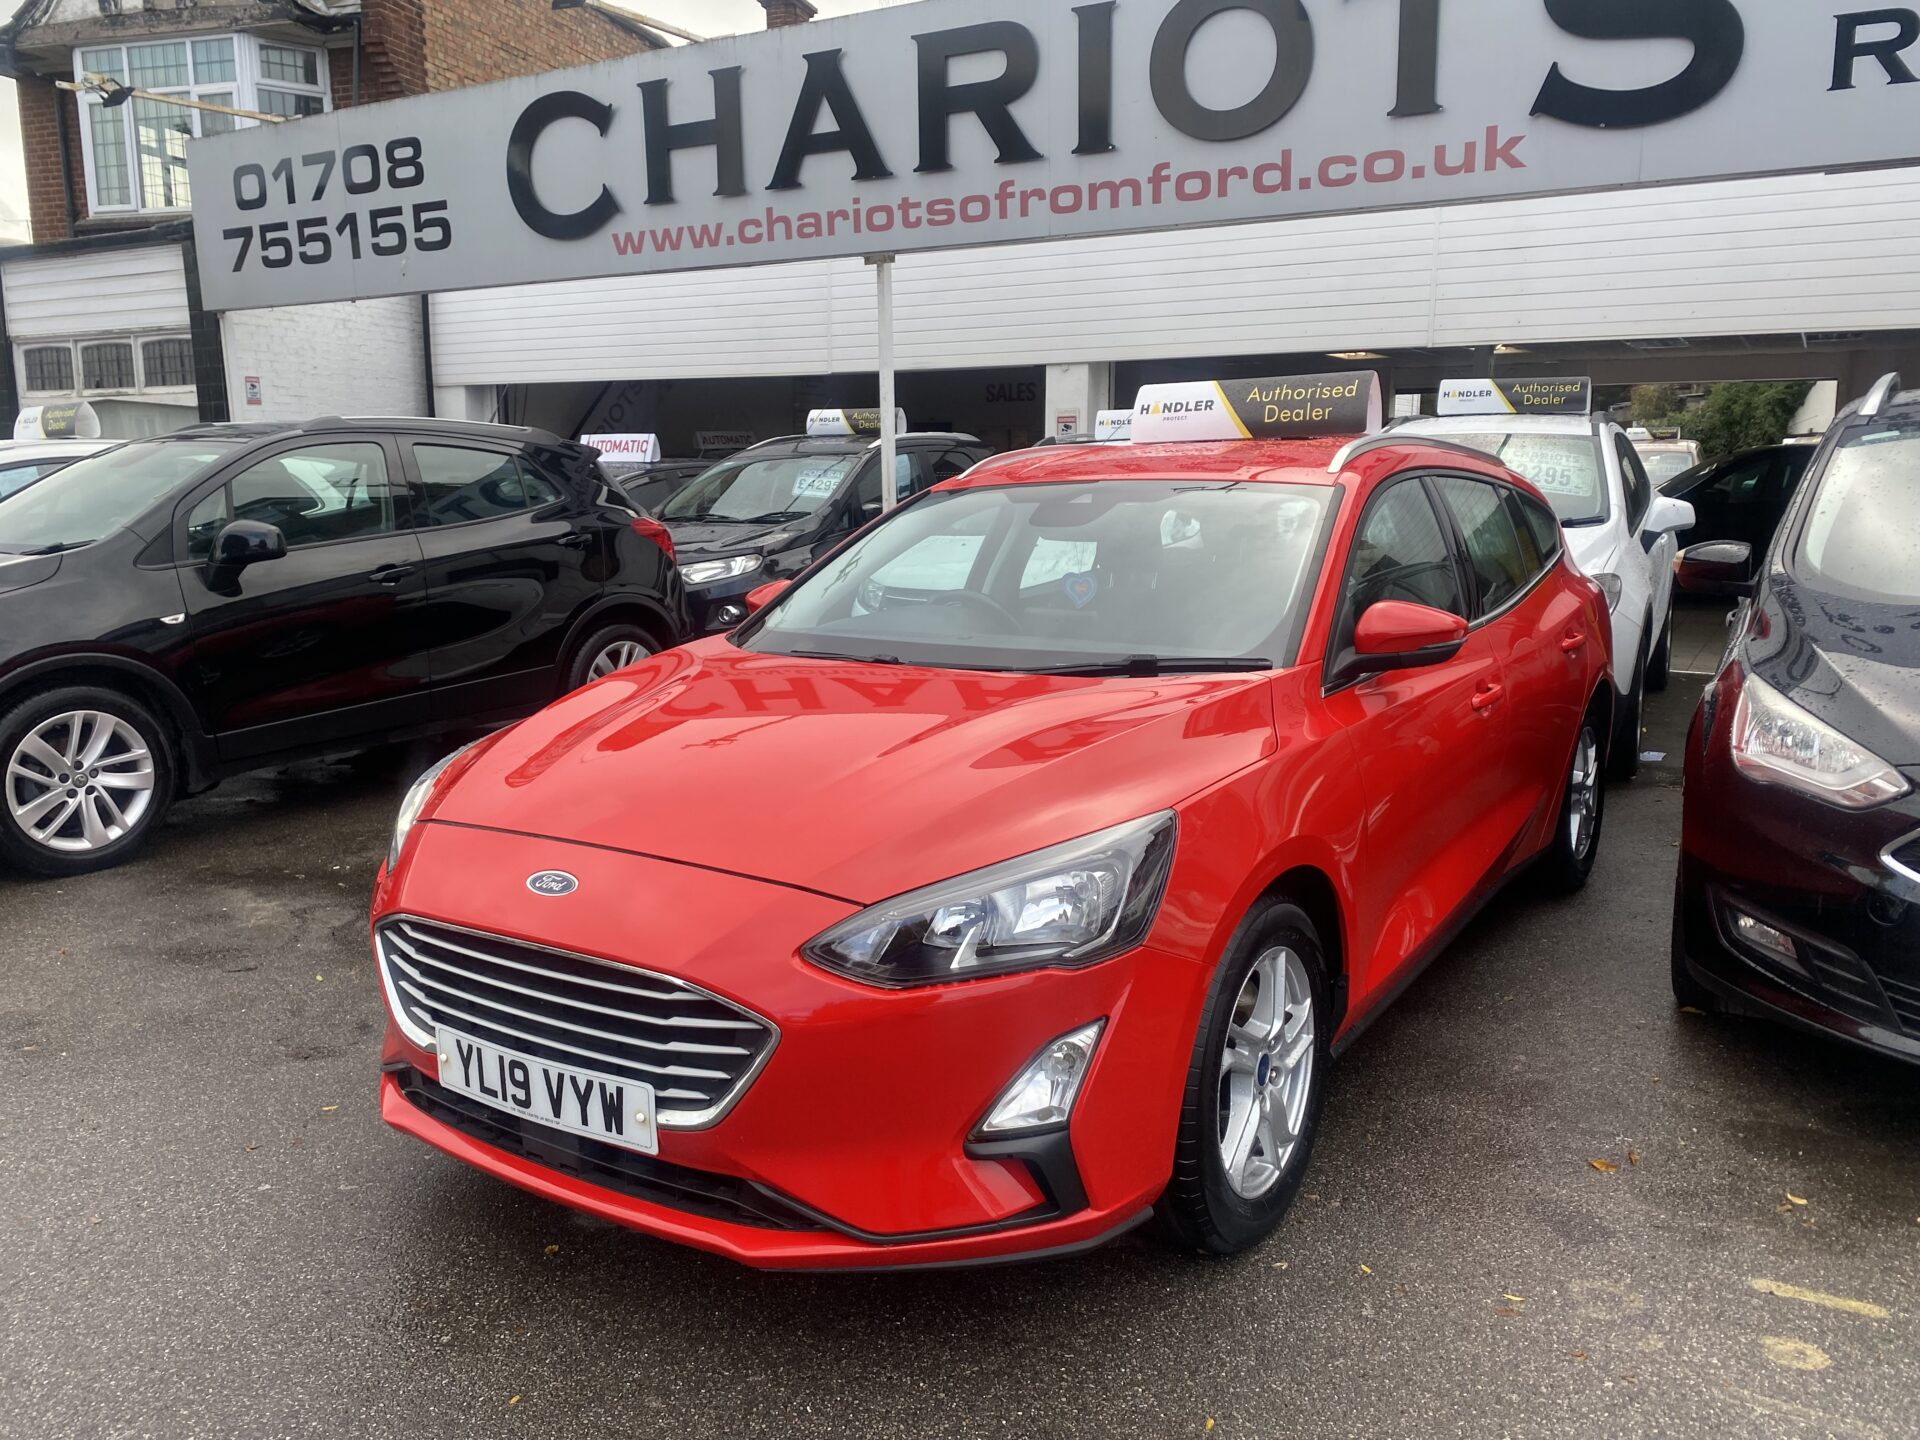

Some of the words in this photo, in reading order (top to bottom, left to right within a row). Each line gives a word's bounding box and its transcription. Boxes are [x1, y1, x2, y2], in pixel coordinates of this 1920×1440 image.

[233, 136, 425, 211] 01708
[612, 125, 1527, 256] www.chariotsofromford.co.uk
[222, 199, 452, 273] 755155
[985, 382, 1037, 403] SALES
[1246, 379, 1359, 403] Authorised
[1443, 390, 1492, 399] HANDLER
[1512, 381, 1582, 393] Authorised
[1140, 399, 1215, 416] HANDLER
[1523, 394, 1567, 405] Dealer
[1264, 402, 1333, 423] Dealer
[859, 420, 881, 429] Deale
[588, 439, 648, 453] UTOMATIC
[535, 874, 568, 891] Ford
[456, 1038, 532, 1110] YL19
[542, 1067, 624, 1136] VYW
